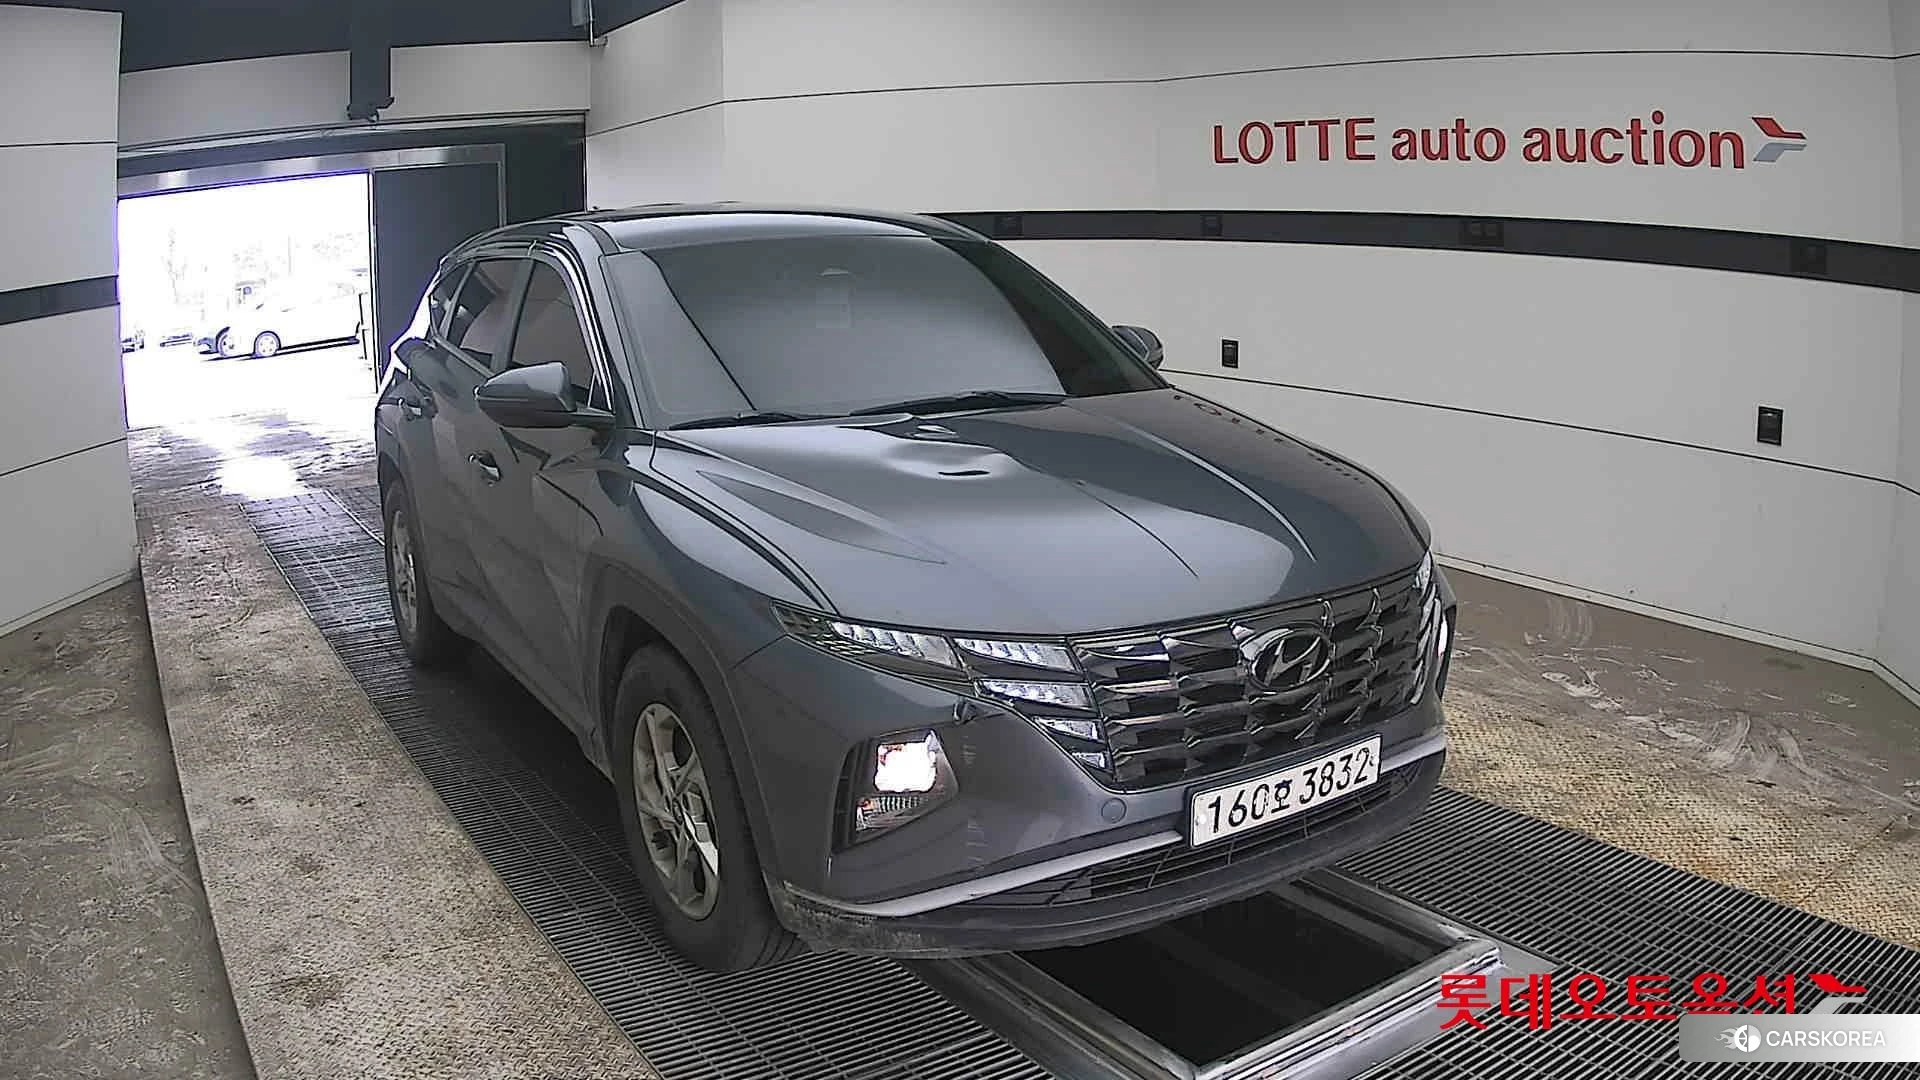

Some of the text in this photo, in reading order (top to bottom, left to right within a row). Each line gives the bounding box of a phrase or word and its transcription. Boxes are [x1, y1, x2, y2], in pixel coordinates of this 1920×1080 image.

[1213, 111, 1746, 169] LOTTE auto auction
[1299, 747, 1370, 805] 3832
